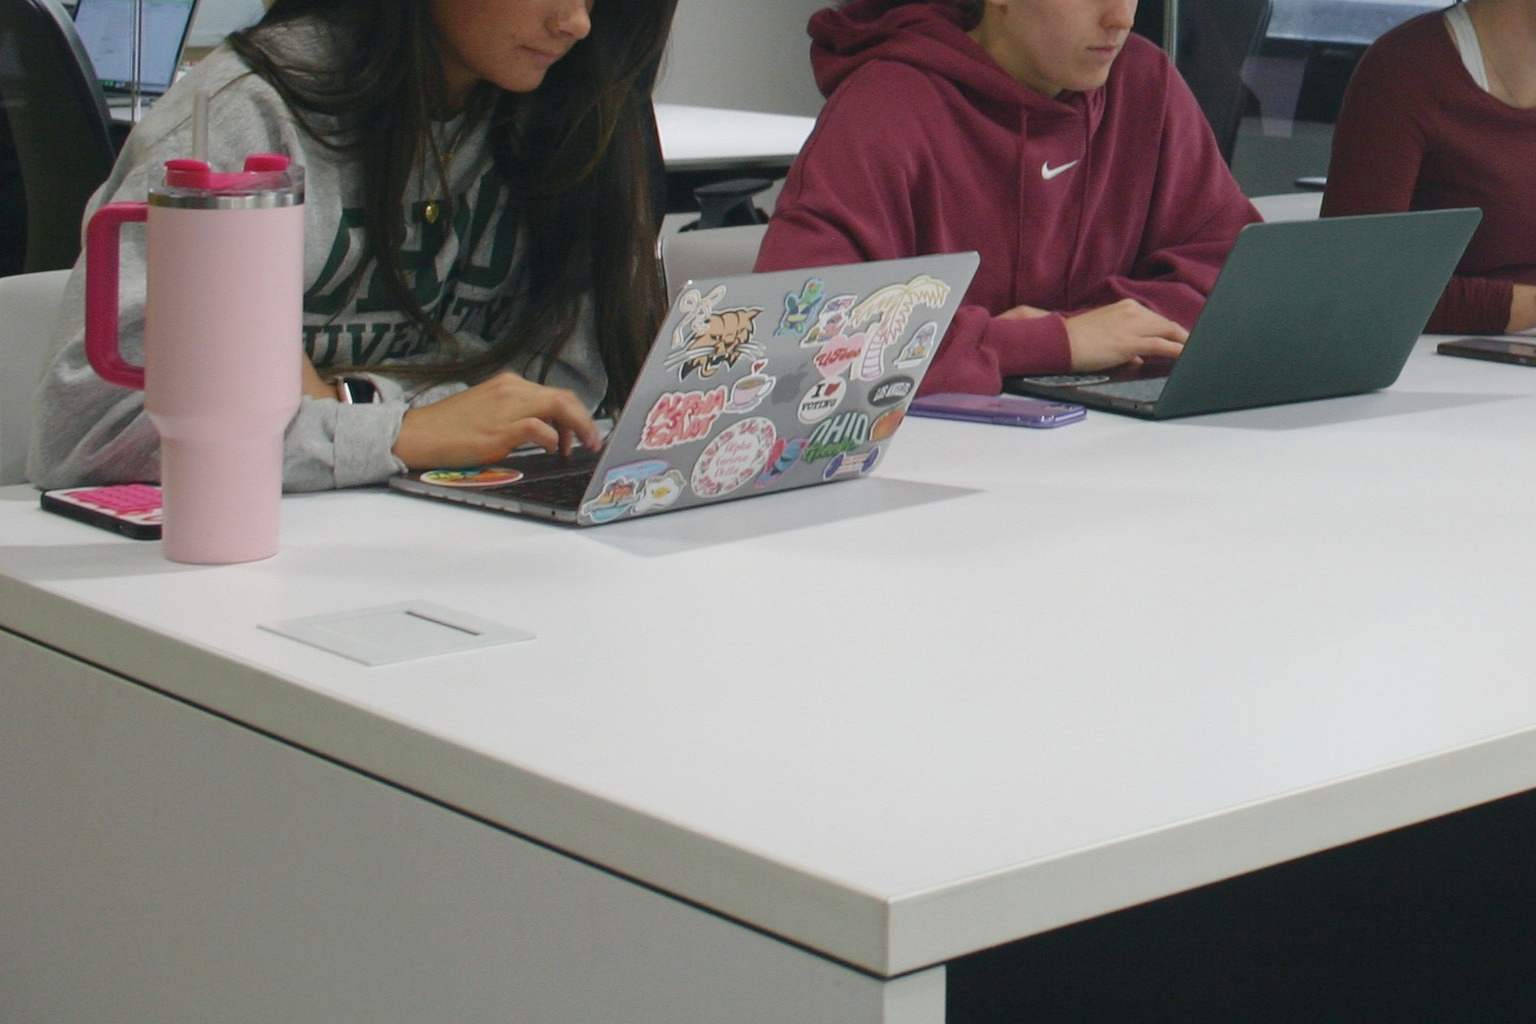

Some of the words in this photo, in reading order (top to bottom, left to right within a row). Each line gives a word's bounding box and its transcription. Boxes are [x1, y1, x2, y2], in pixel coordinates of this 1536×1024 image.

[811, 383, 825, 398] I
[801, 398, 837, 411] VOTING
[808, 412, 868, 446] OHIO
